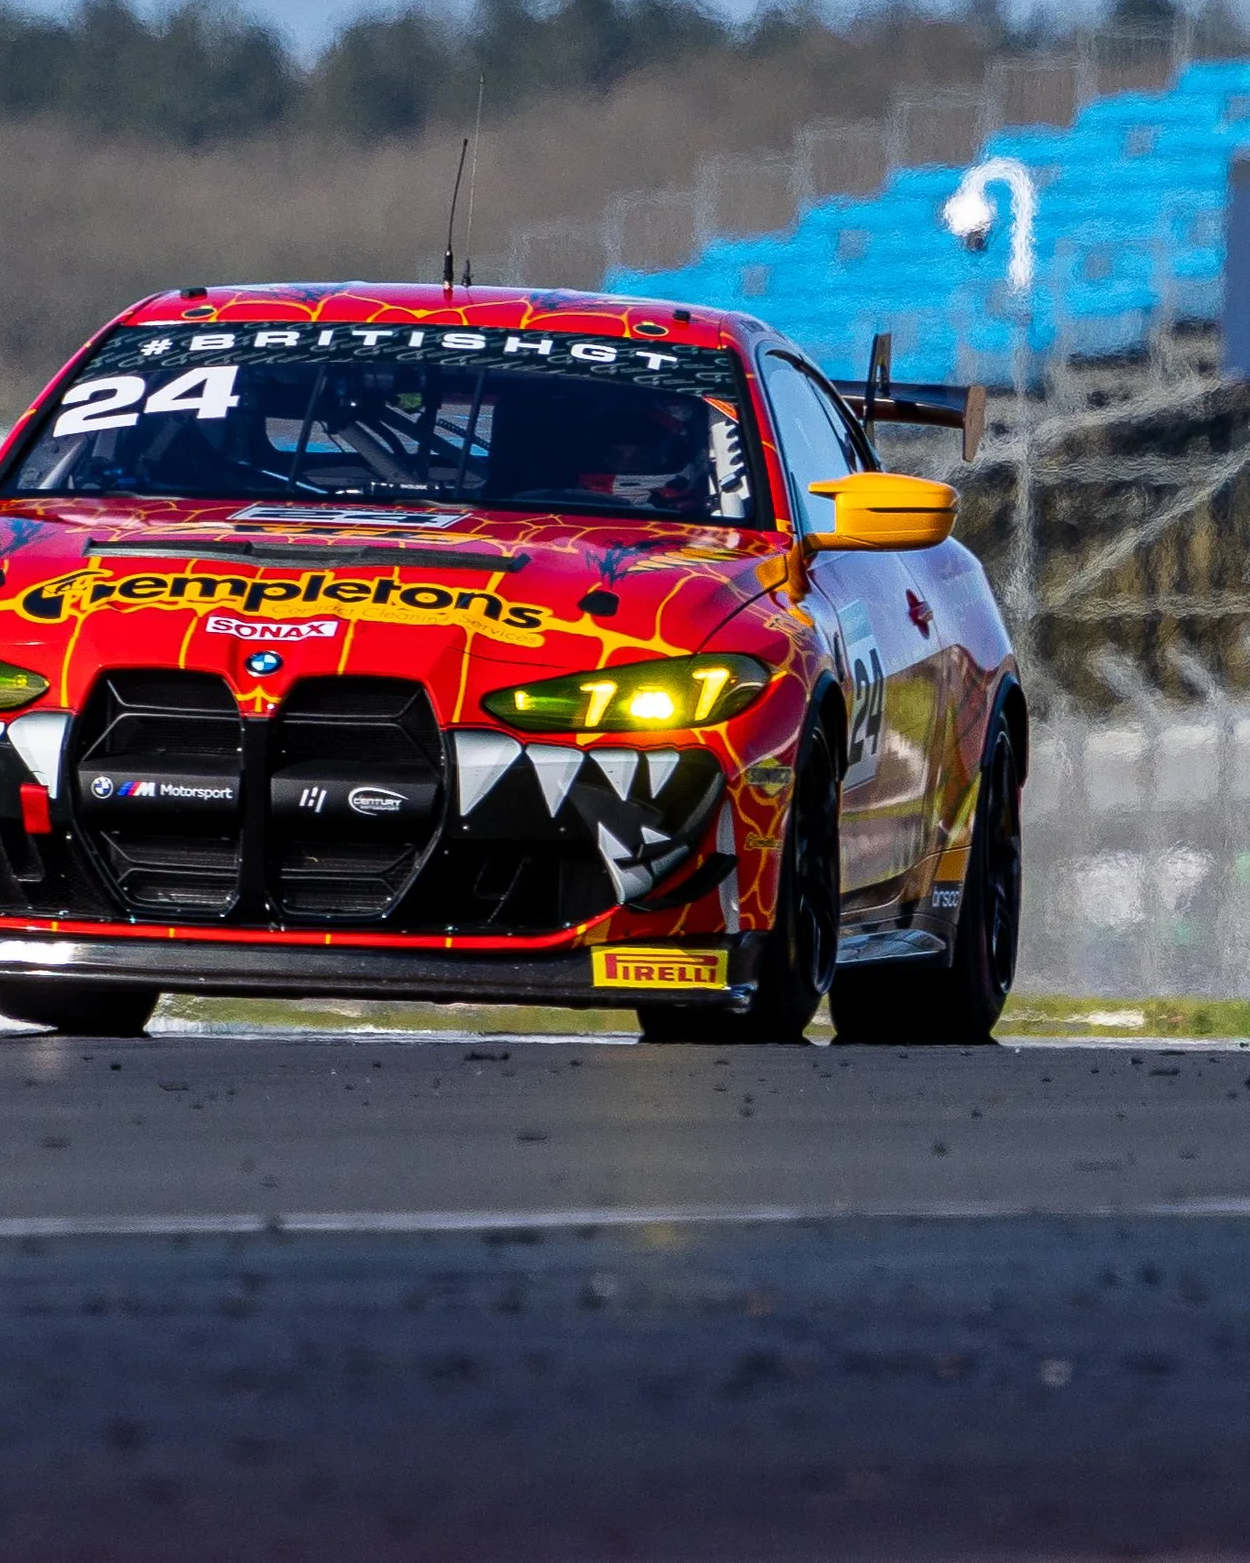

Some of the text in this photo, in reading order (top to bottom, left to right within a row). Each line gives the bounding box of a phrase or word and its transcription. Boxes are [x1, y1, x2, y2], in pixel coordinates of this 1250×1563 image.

[53, 365, 240, 438] 24
[211, 618, 327, 640] SONAX
[460, 613, 540, 644] Services
[848, 647, 884, 765] 24
[159, 783, 233, 800] Motorsport
[353, 797, 403, 807] CENTURY
[604, 953, 719, 984] PIRELLI
